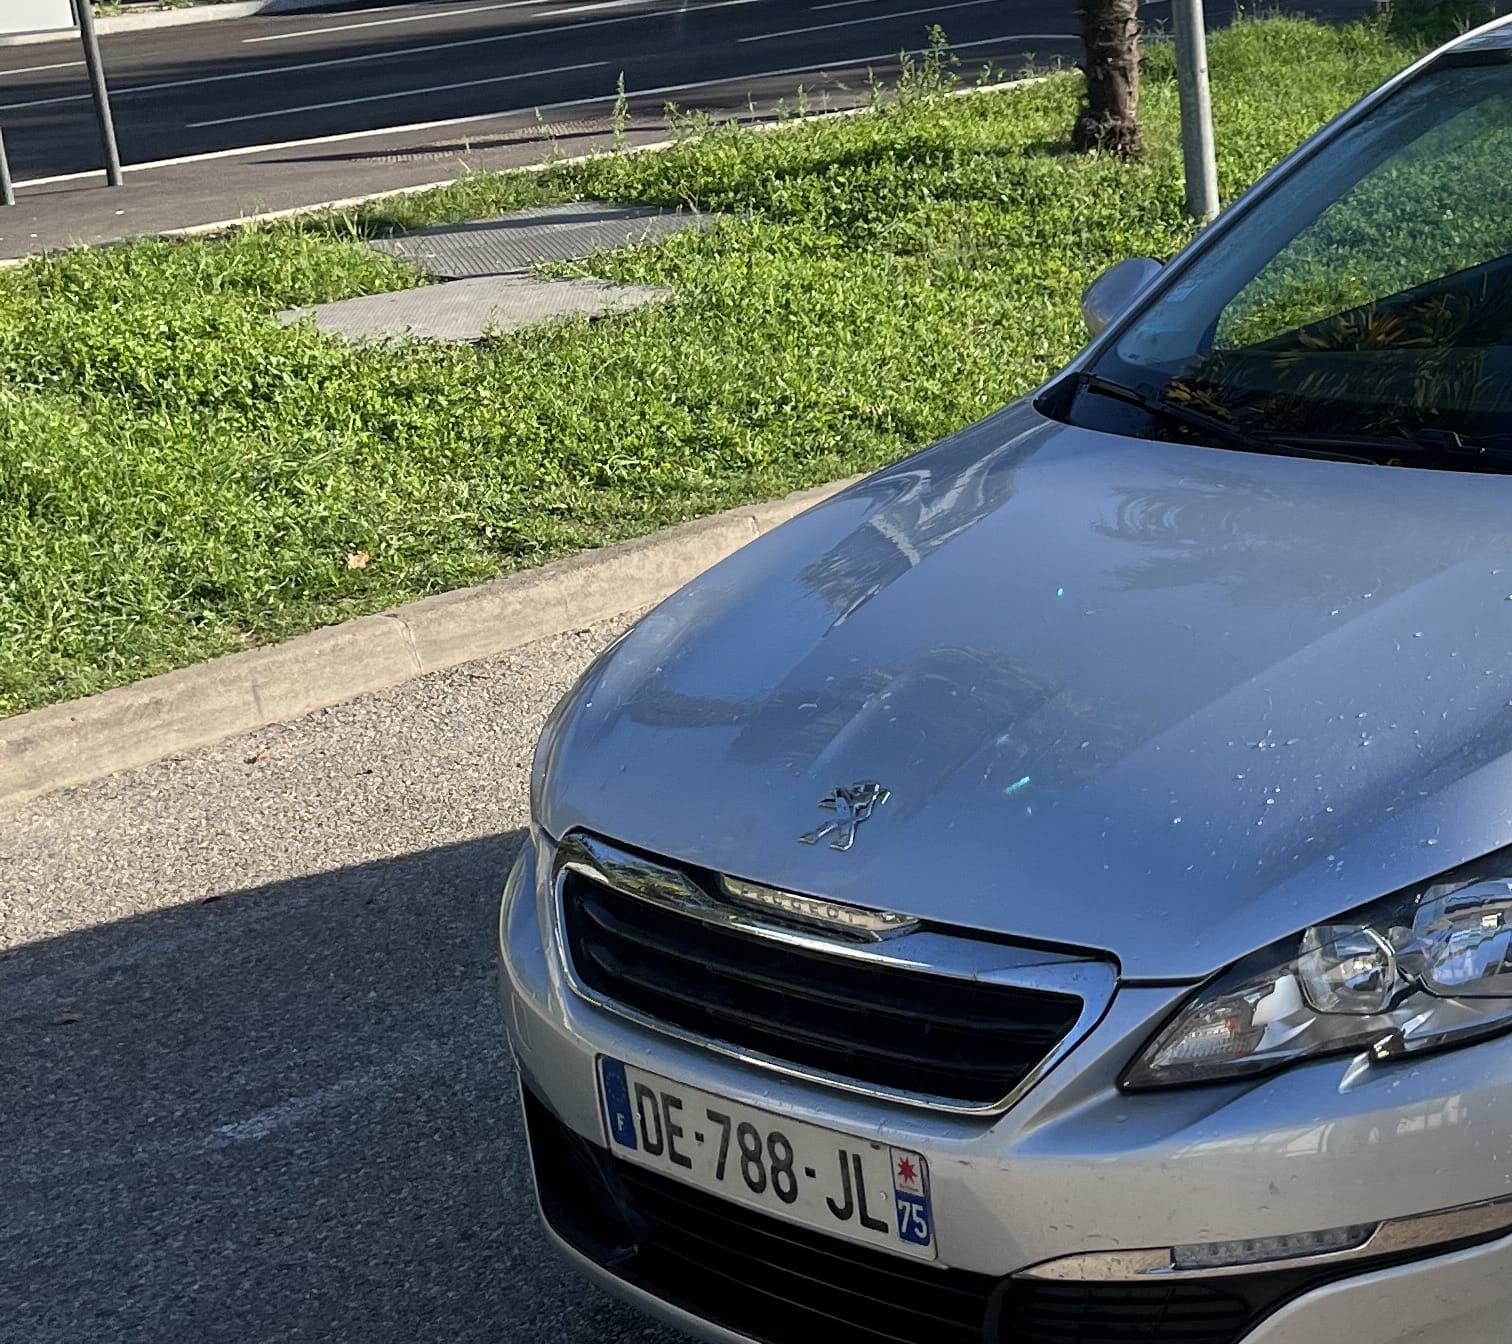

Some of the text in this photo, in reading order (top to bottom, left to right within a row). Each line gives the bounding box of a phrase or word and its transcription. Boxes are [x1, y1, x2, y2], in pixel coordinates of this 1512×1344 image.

[616, 1113, 626, 1132] F
[633, 1081, 889, 1234] DE-788-JL
[897, 1198, 928, 1239] 75
